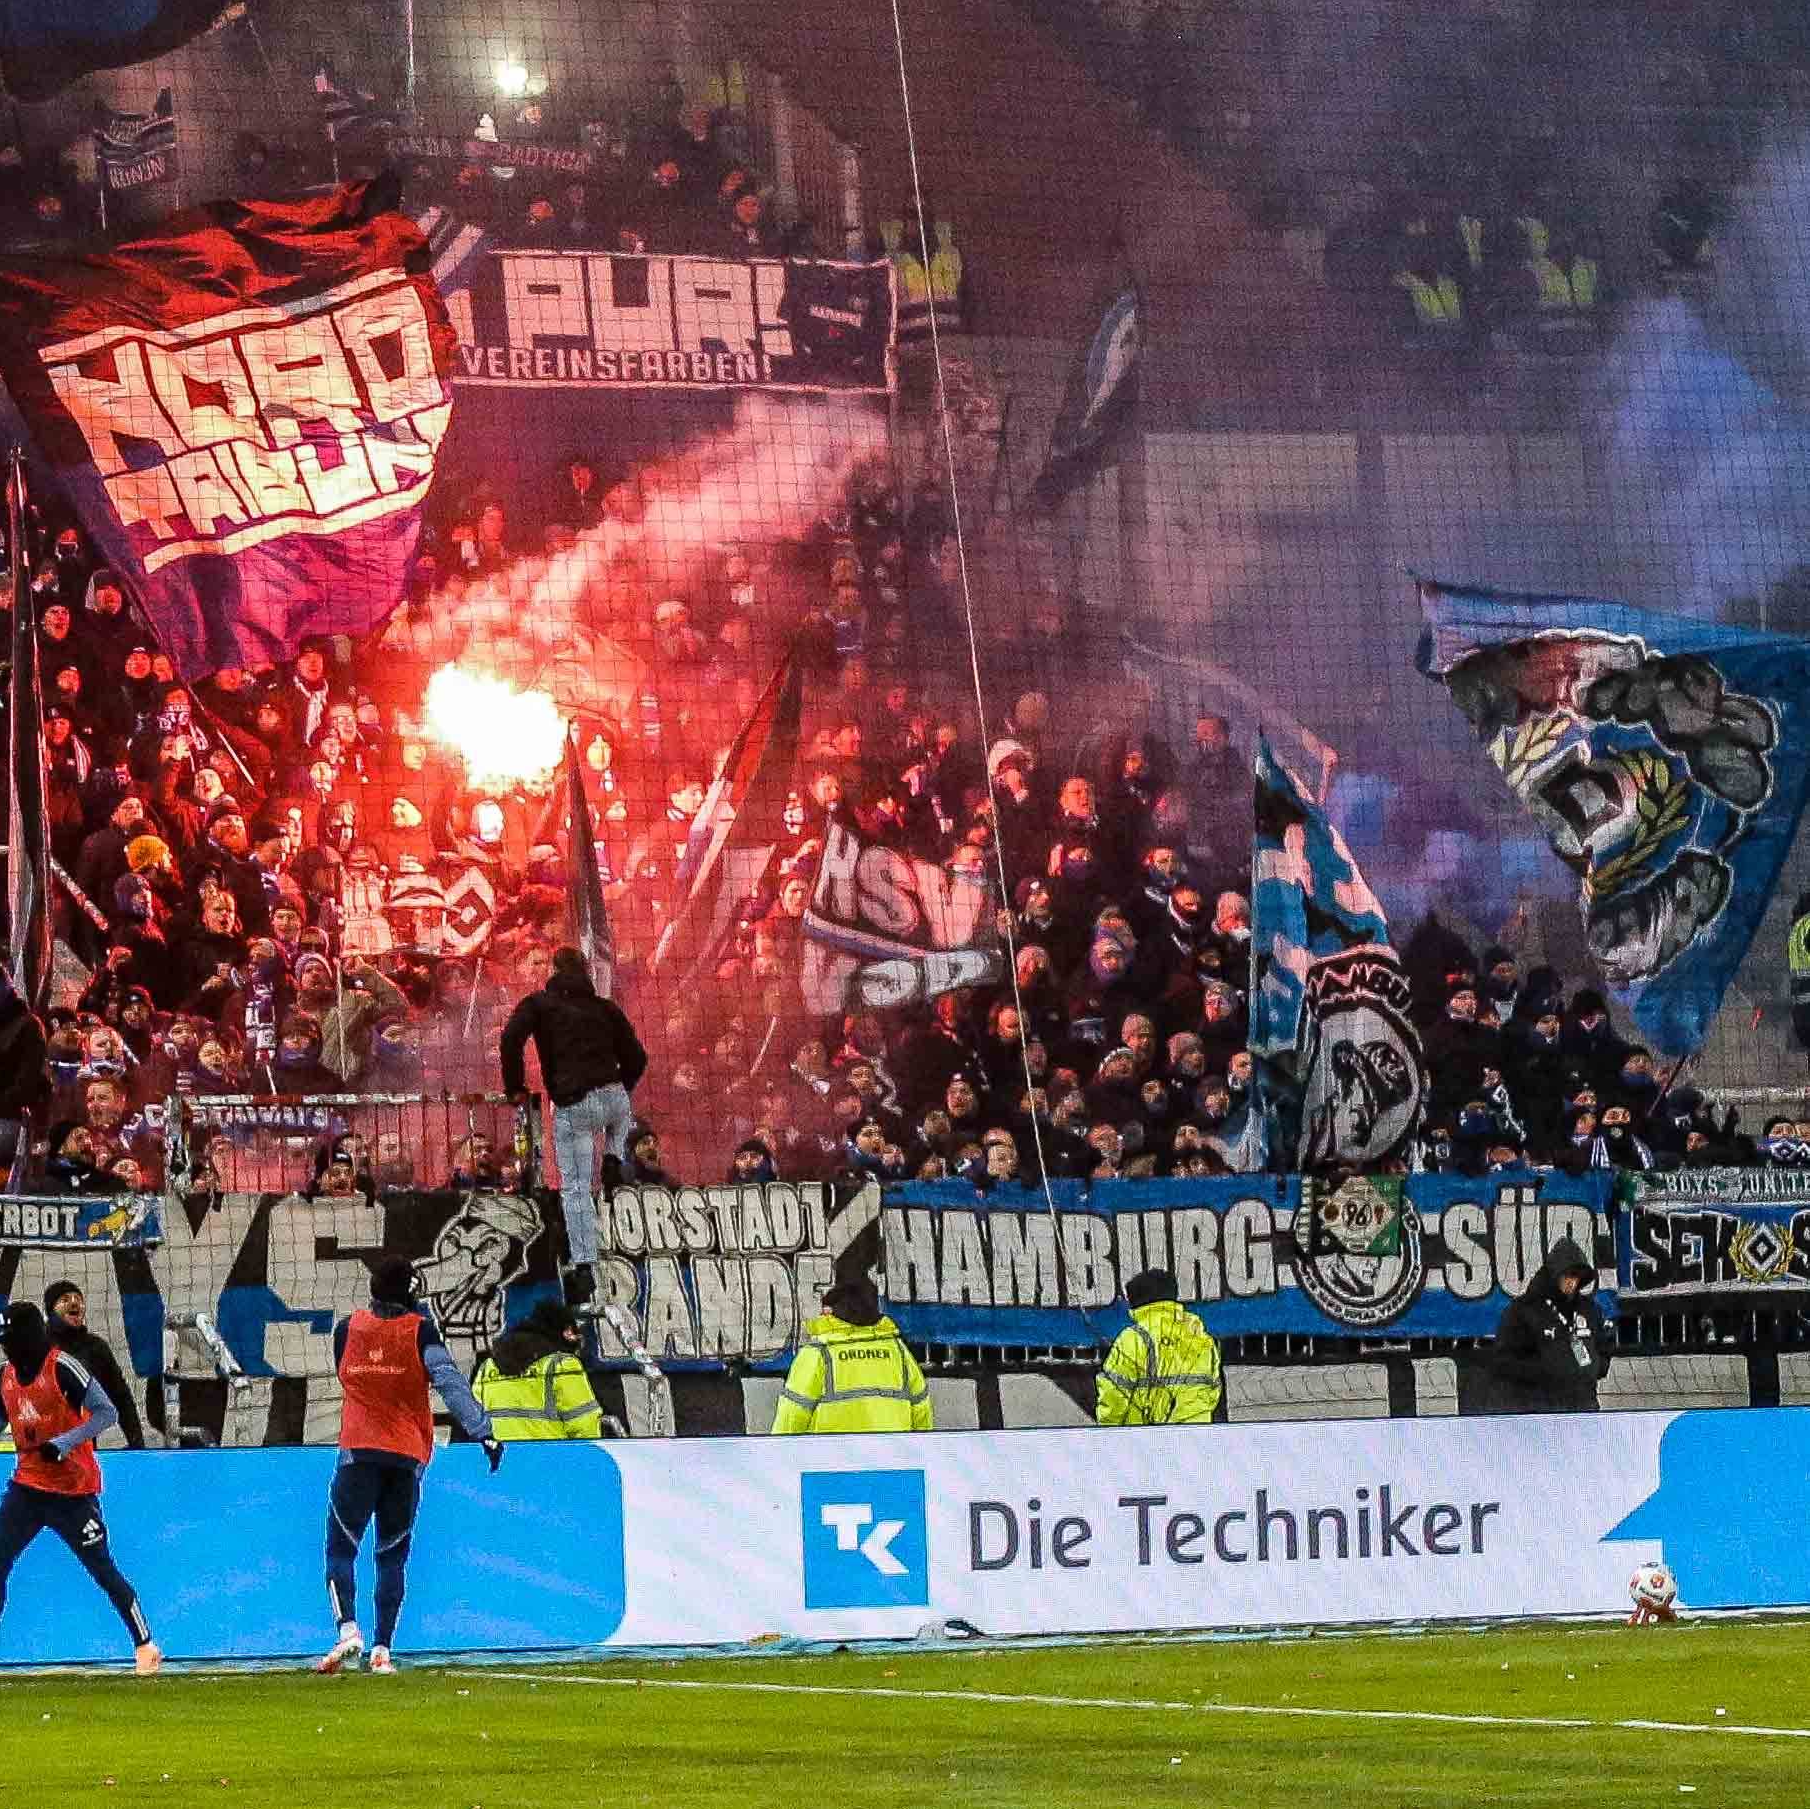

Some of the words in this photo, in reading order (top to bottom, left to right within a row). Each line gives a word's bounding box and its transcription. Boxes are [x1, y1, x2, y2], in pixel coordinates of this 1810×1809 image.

[461, 347, 772, 383] VEREINSFARBEN!
[884, 1198, 1276, 1306] HAMBURG
[837, 1345, 893, 1362] ORDNER
[821, 1502, 910, 1576] TK
[967, 1496, 1092, 1574] Die
[1118, 1483, 1502, 1568] Techniker
